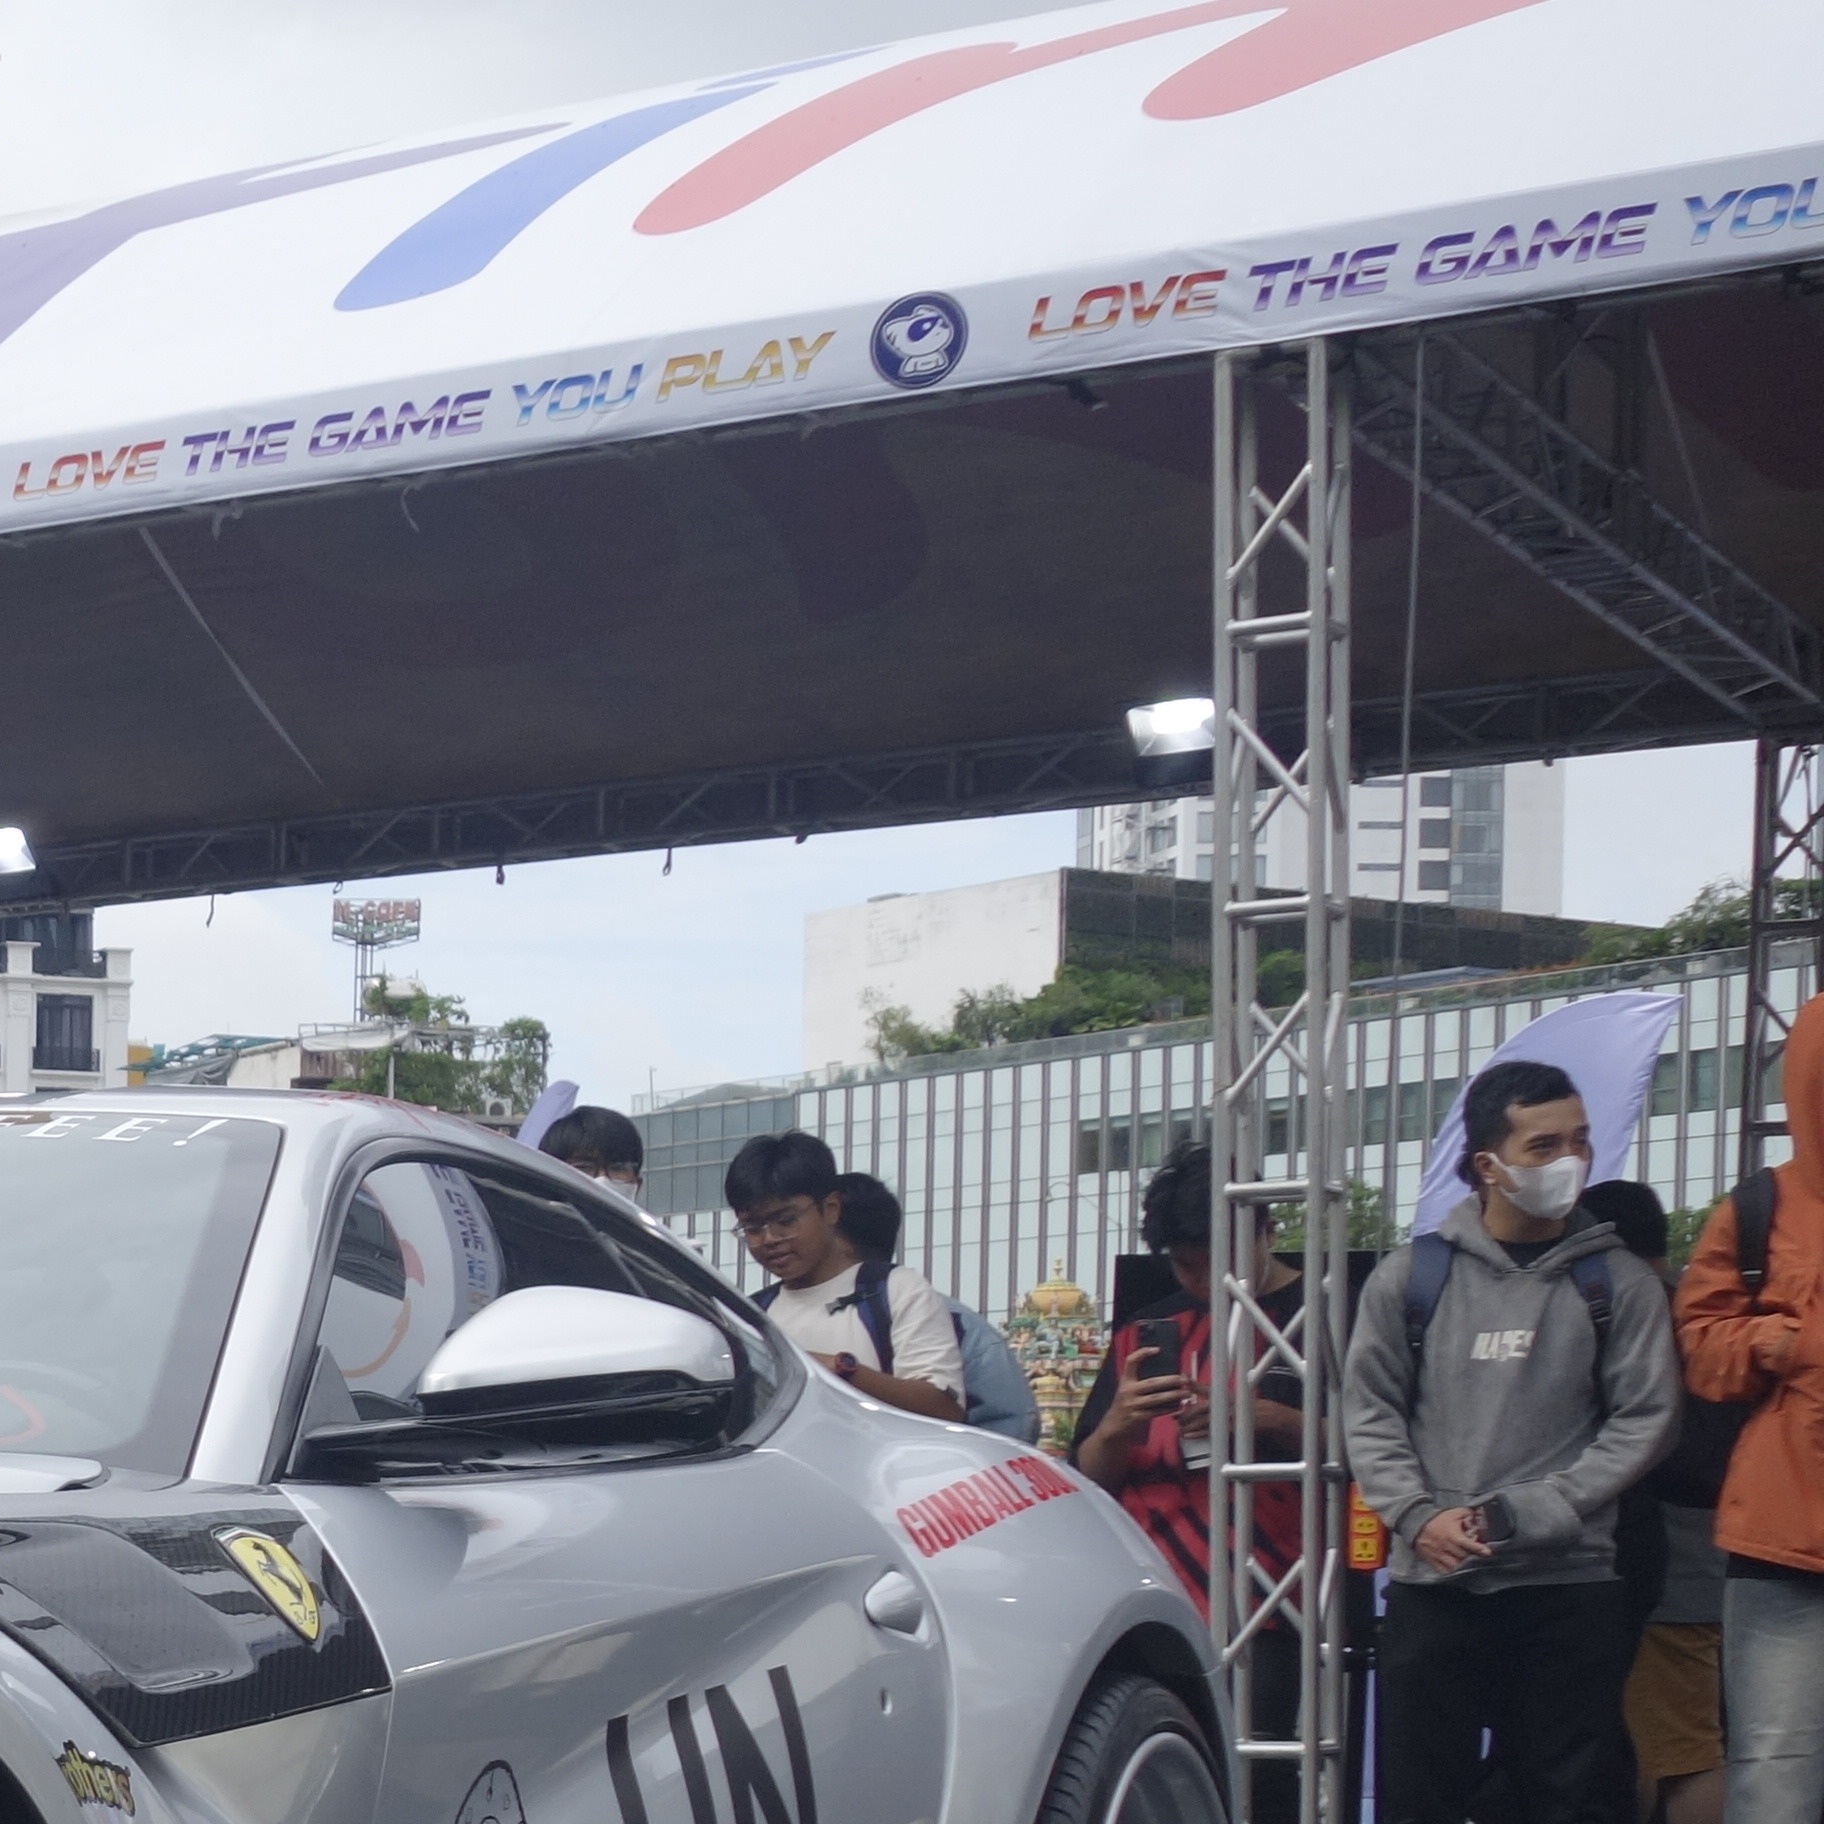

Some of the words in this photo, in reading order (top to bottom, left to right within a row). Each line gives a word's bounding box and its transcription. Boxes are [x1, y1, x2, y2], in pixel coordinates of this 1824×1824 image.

[1027, 268, 1228, 344] LOVE
[1248, 242, 1399, 312] THE
[1414, 202, 1658, 286] GAME
[12, 439, 167, 501] LOVE
[182, 419, 297, 476] THE
[307, 389, 492, 458] GAME
[512, 362, 644, 427] YOU
[655, 330, 838, 404] PLAY
[896, 1465, 1036, 1558] GUMBALL
